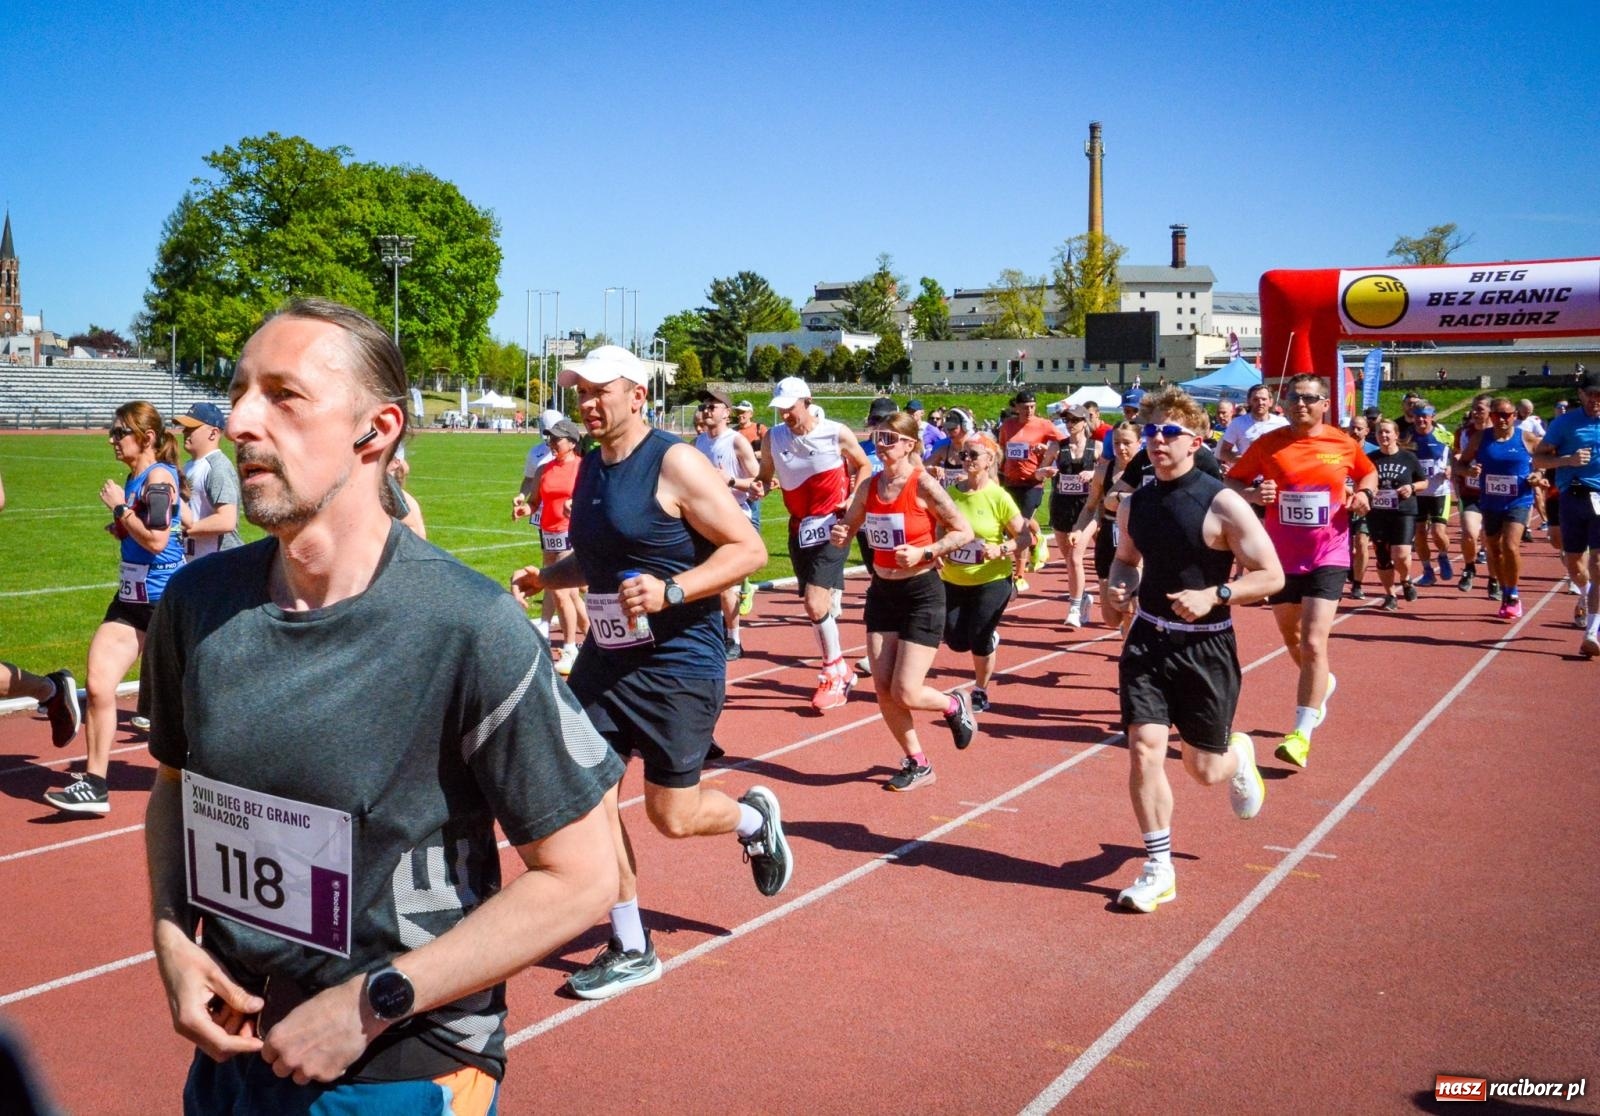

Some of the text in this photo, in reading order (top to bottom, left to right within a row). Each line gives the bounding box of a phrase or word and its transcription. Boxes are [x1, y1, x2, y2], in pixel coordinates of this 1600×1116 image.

[1469, 270, 1528, 283] BIEG
[1427, 287, 1572, 307] BEZ GRANIC
[1438, 309, 1560, 328] RACIBÓRZ
[1063, 482, 1081, 491] 228
[1491, 483, 1507, 492] 143
[1287, 506, 1314, 520] 155
[804, 527, 826, 541] 218
[869, 530, 889, 544] 163
[546, 537, 562, 548] 188
[594, 618, 626, 639] 105
[192, 784, 311, 829] XVIII BIEG BEZ GRANIC
[193, 801, 250, 830] 3MAJA2026
[215, 842, 285, 910] 118
